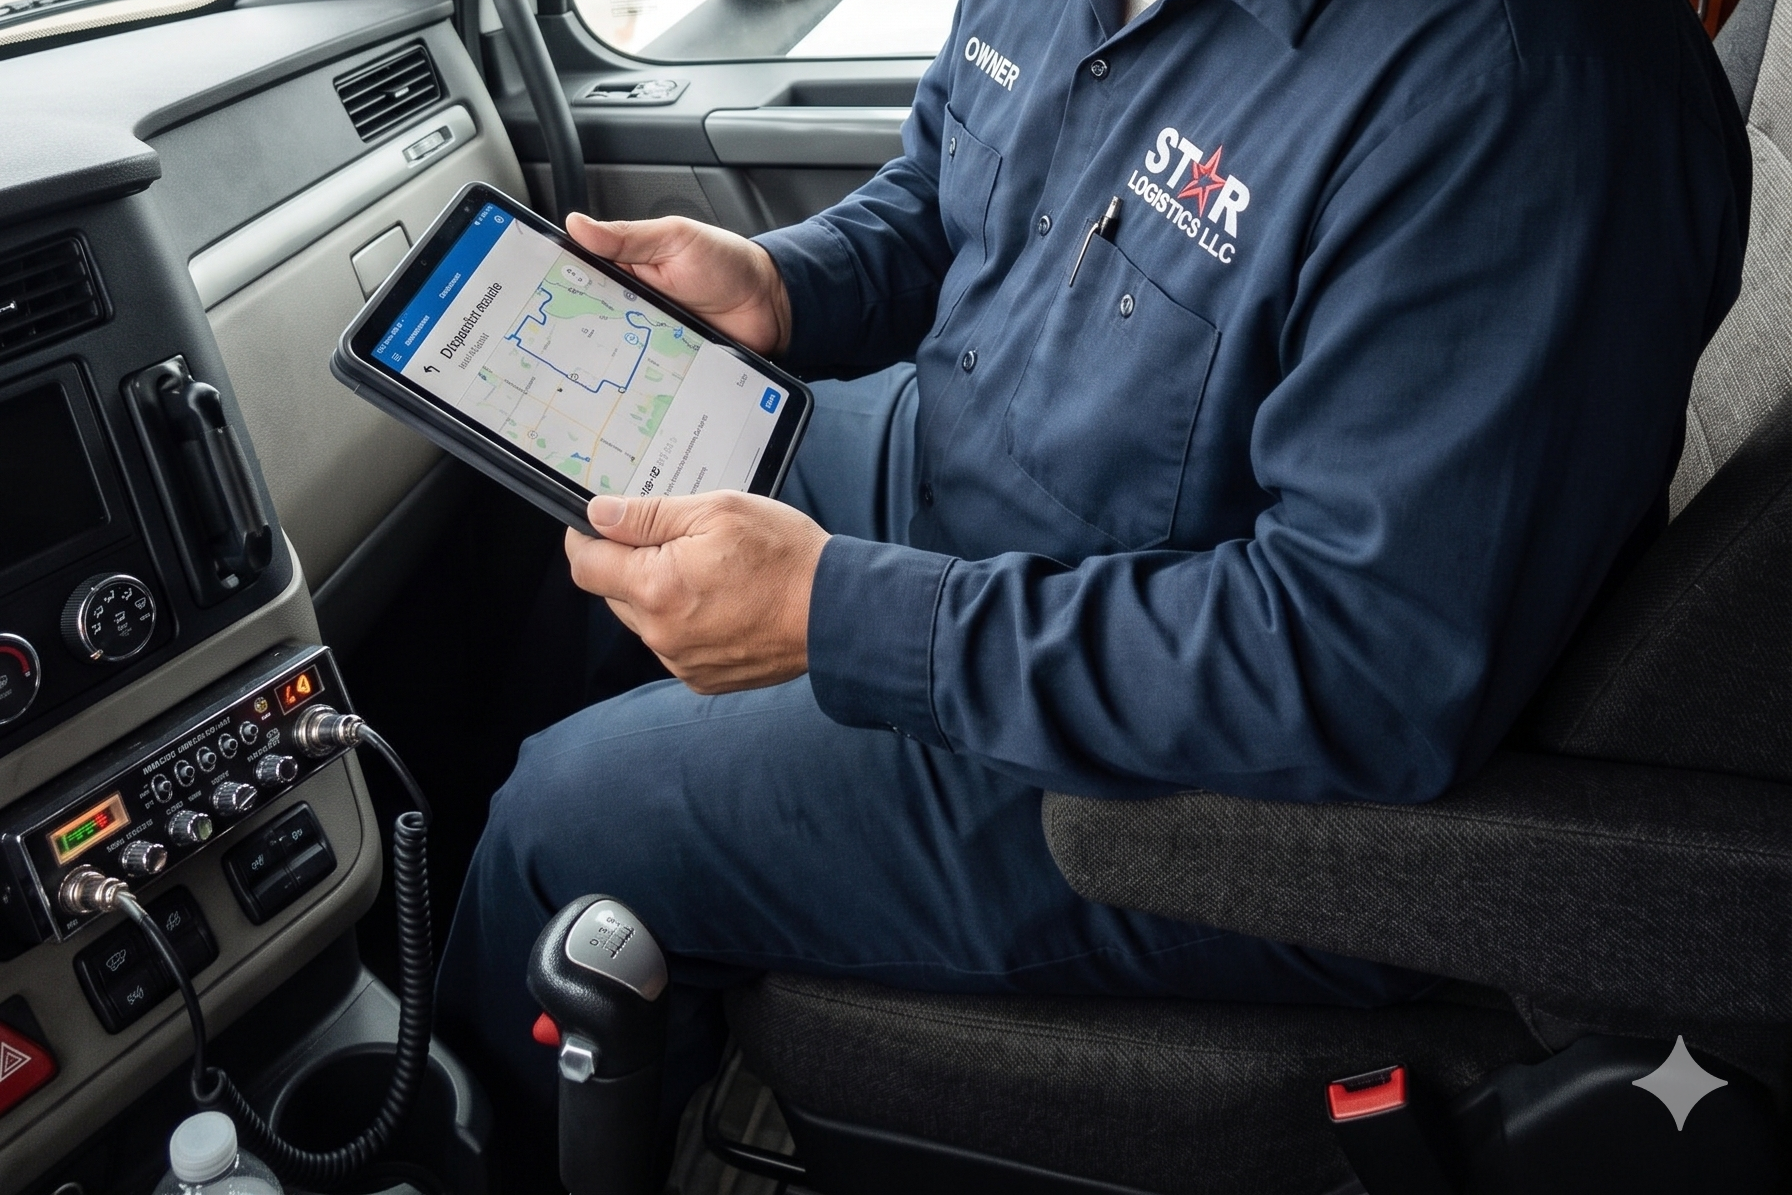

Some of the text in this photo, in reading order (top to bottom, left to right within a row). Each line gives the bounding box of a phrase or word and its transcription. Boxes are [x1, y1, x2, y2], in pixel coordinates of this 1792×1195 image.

[964, 36, 1020, 91] OWNER
[1127, 169, 1236, 264] LOGISTICS LLC
